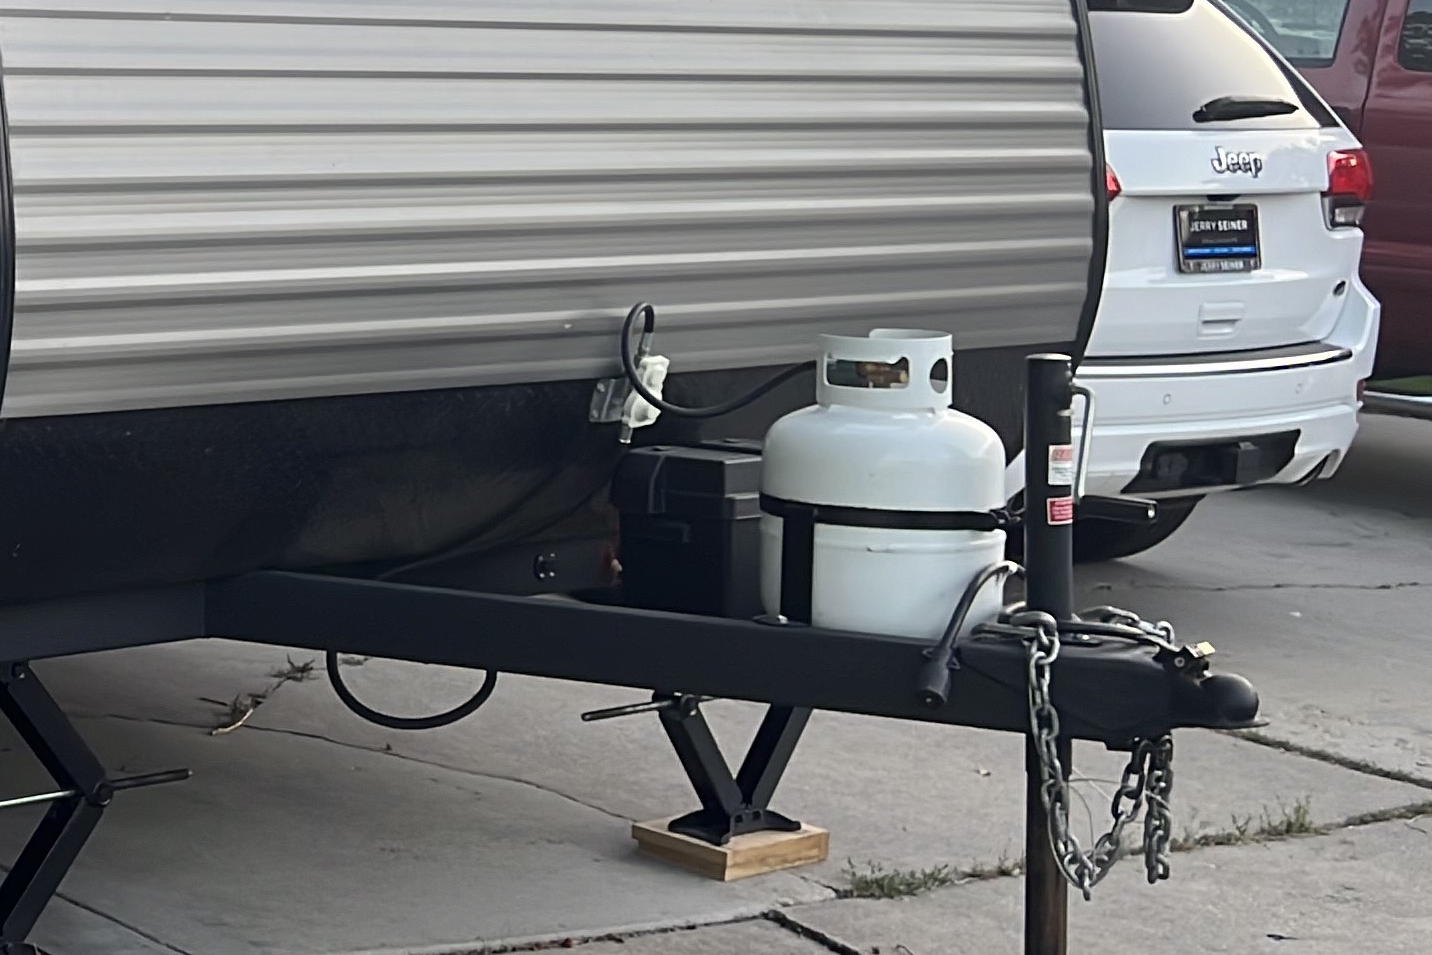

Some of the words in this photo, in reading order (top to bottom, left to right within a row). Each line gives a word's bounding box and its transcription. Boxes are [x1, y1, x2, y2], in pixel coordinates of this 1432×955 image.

[1211, 146, 1263, 178] Jeep
[1190, 220, 1216, 232] JERRY
[1218, 219, 1248, 232] SEINER
